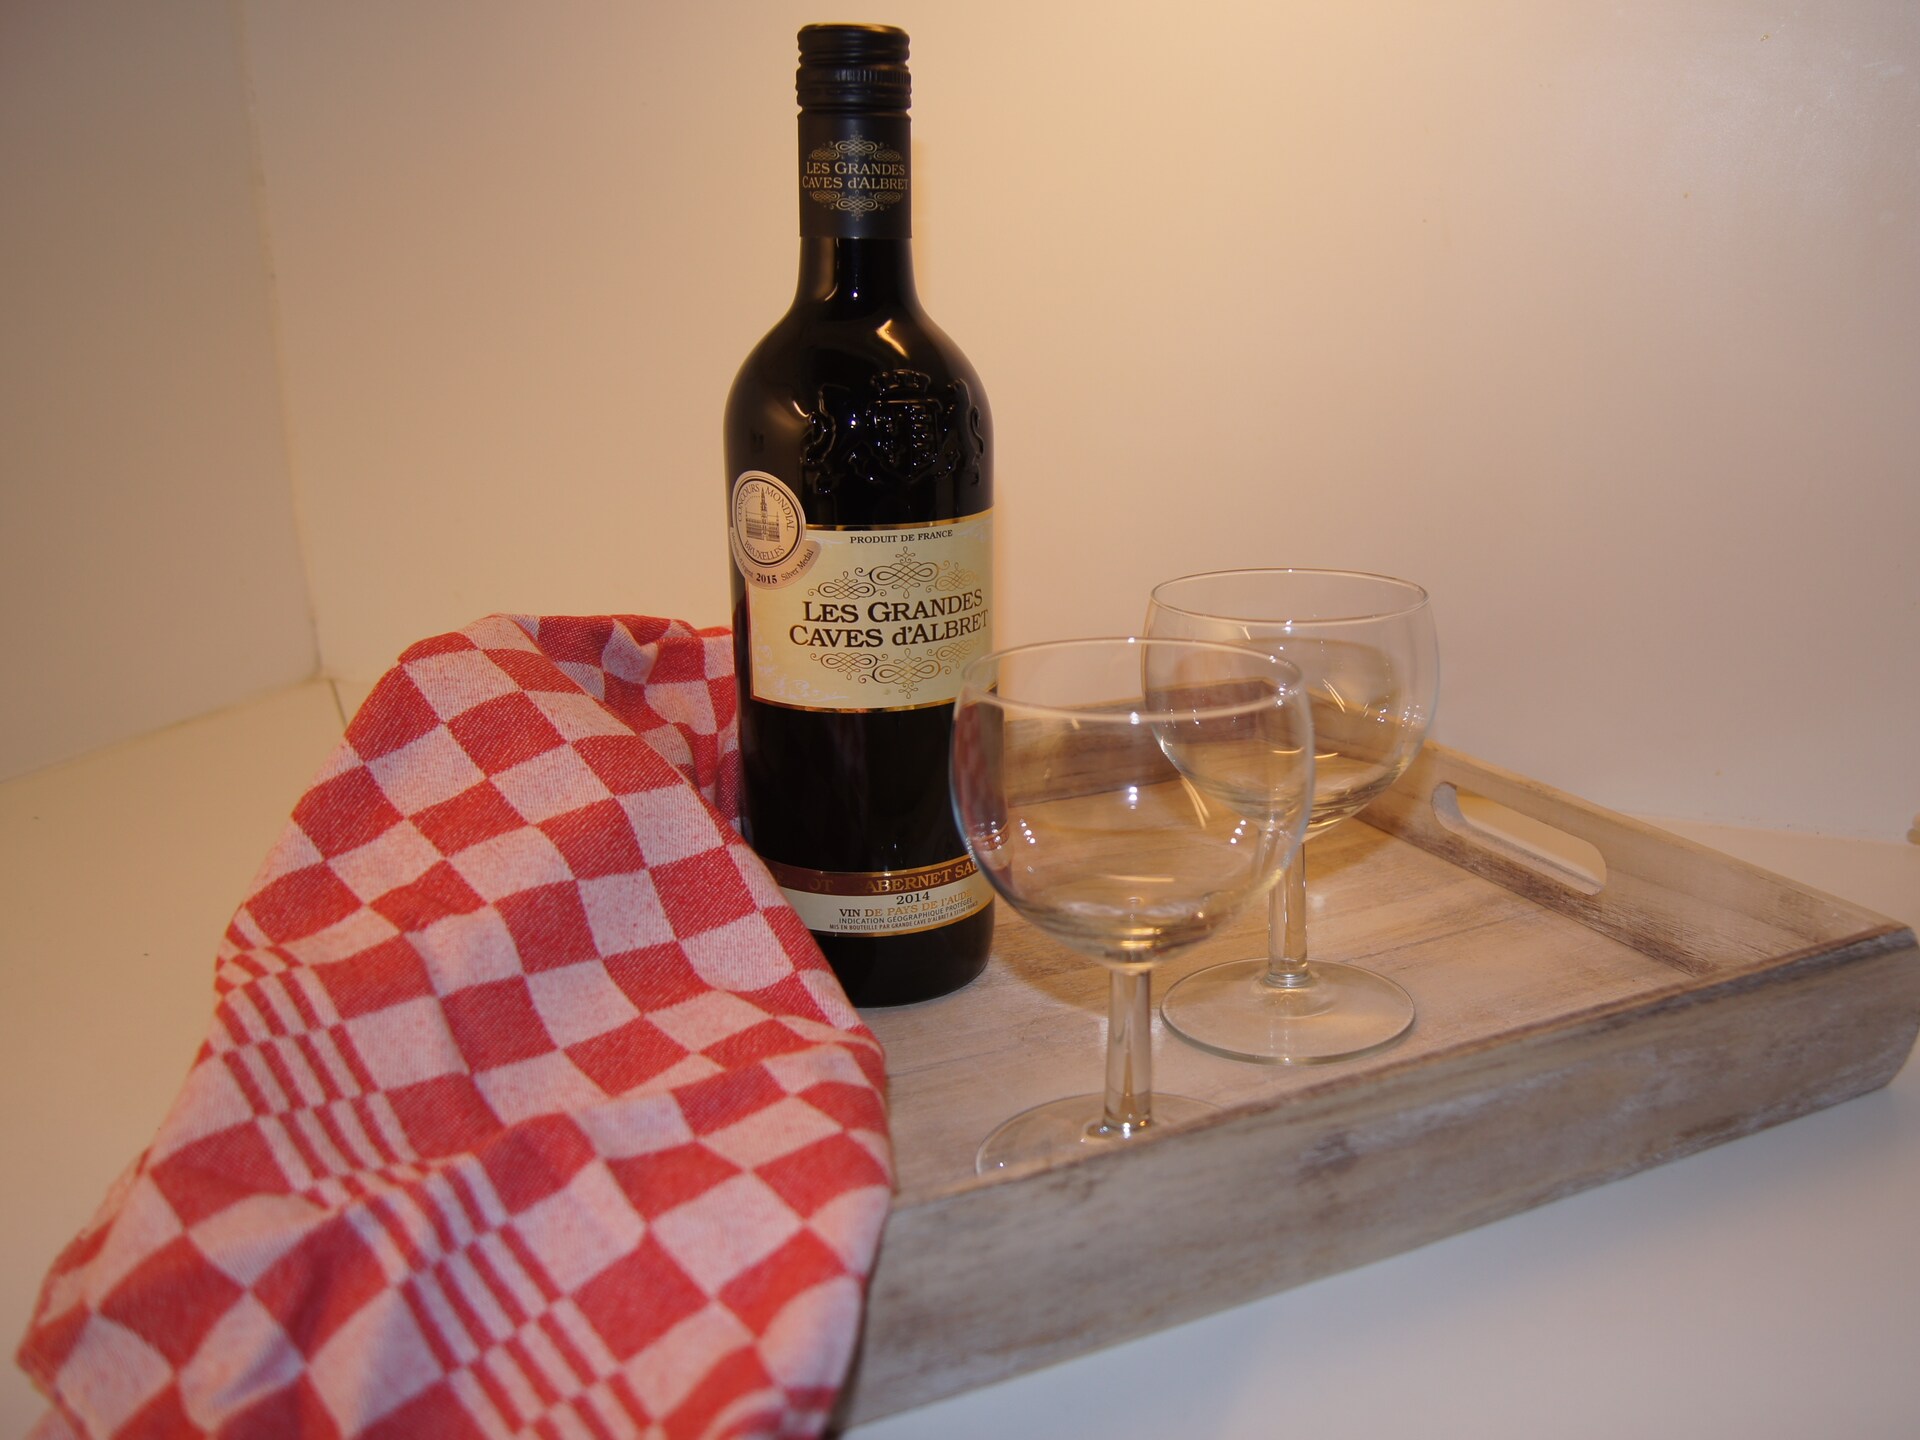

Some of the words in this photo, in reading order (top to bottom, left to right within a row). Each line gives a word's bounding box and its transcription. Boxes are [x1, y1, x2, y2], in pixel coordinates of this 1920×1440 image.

[806, 161, 830, 175] LES
[834, 161, 906, 176] GRANDES
[802, 175, 843, 189] CAVES
[847, 177, 909, 190] d'ALBRET
[765, 487, 795, 532] MONDIAL
[850, 535, 898, 545] PRODUIT
[900, 534, 915, 543] DE
[917, 529, 953, 541] FRANCE
[744, 540, 785, 561] BRUXELLES
[756, 573, 778, 585] 2015
[781, 569, 799, 582] Silver
[796, 548, 815, 571] Medal
[803, 601, 860, 624] LES
[867, 589, 984, 623] GRANDES
[789, 624, 884, 648] CAVES
[891, 609, 989, 646] d'ALBRET
[864, 868, 952, 893] ABERNET
[896, 891, 930, 905] 2014
[839, 908, 861, 918] VIN
[864, 908, 883, 918] DE
[887, 904, 918, 917] PAYS
[922, 900, 938, 912] DE
[838, 917, 885, 925] INDICATION
[848, 923, 878, 931] BOUTEILLE
